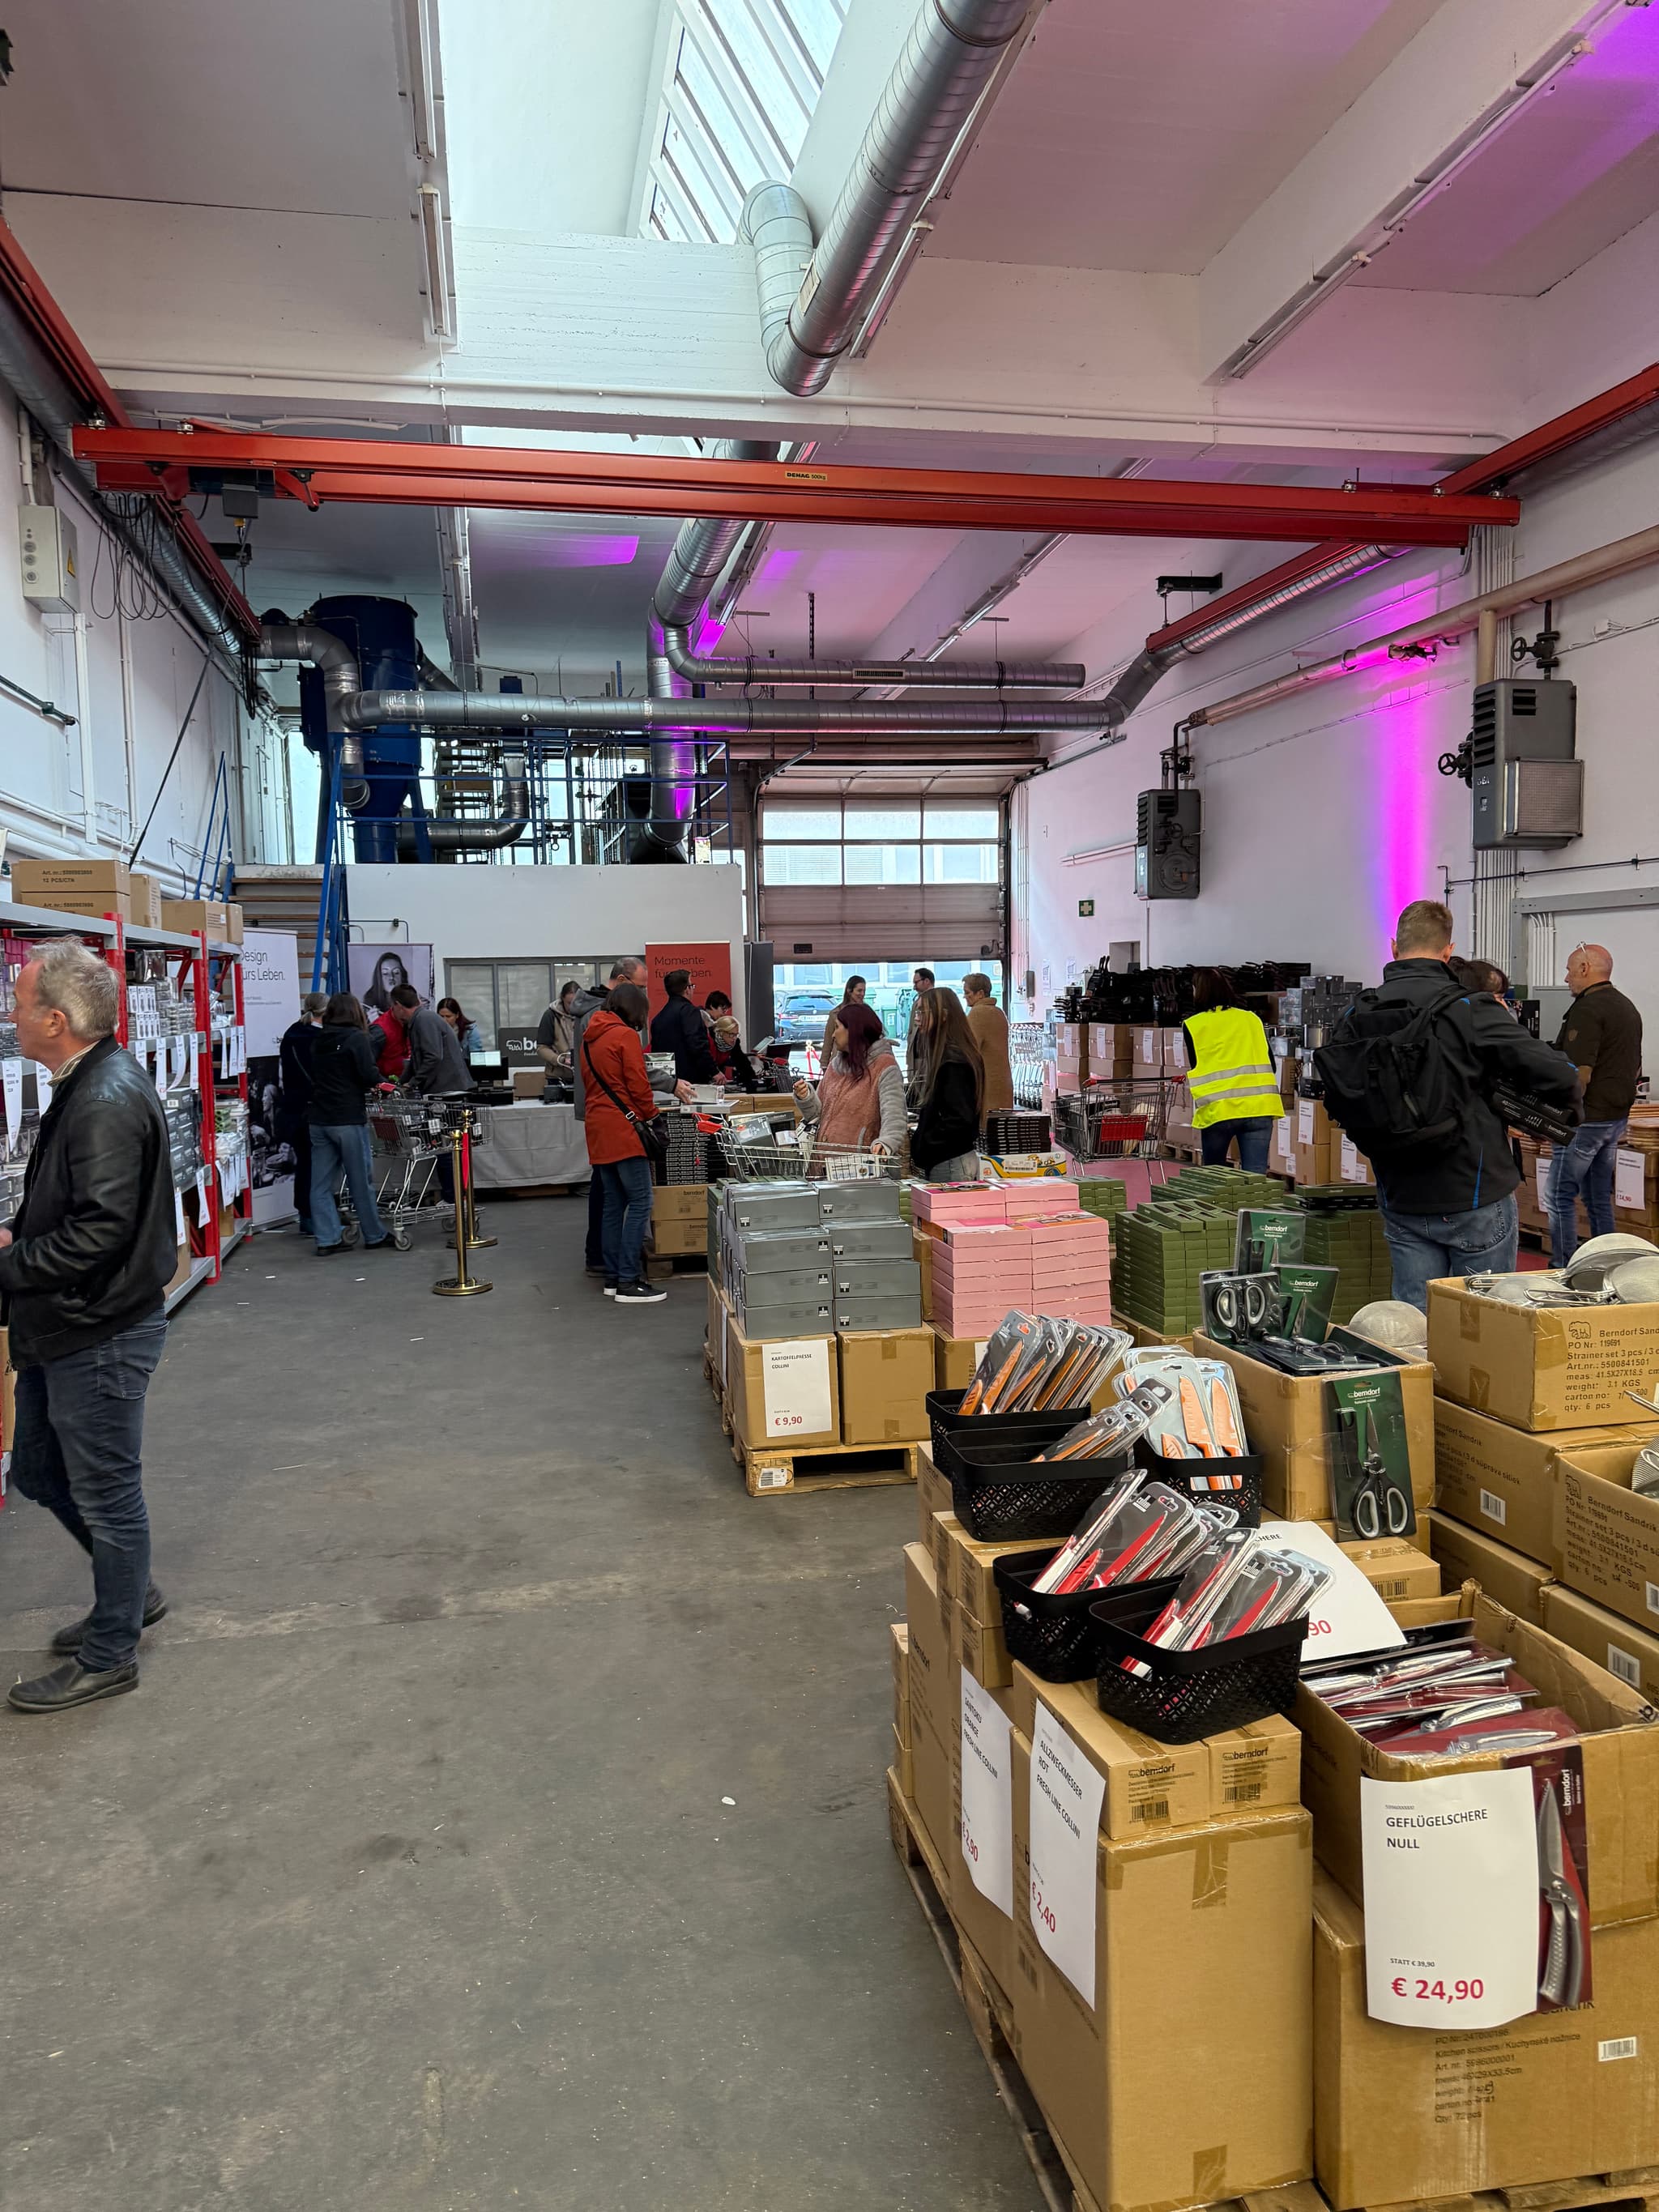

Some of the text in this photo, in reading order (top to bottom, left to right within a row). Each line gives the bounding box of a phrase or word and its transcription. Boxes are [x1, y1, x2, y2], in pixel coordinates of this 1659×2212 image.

[655, 956, 706, 966] Momente
[242, 967, 286, 981] ürs Leben.
[1265, 1224, 1288, 1232] berndorf
[1294, 1280, 1319, 1288] berndorf
[1599, 1328, 1637, 1338] Berndorf
[1567, 1341, 1581, 1349] PO
[771, 1353, 812, 1362] KARTOFFELPRESSE
[1567, 1352, 1604, 1361] Strainer
[1605, 1350, 1618, 1358] set
[1621, 1349, 1627, 1357] 3
[1627, 1349, 1643, 1358] pcs
[1648, 1348, 1654, 1356] 3
[1621, 1379, 1641, 1387] KGS
[1354, 1387, 1381, 1398] berndorf
[1595, 1401, 1611, 1413] pcs
[774, 1416, 803, 1426] € 9,90
[1587, 1495, 1657, 1532] Berndorf Sandrik
[1614, 1562, 1633, 1577] KGS
[1234, 1746, 1269, 1760] berndorf
[1038, 1755, 1051, 1775] ROT
[1039, 1739, 1083, 1801] ALLZWECKMESSER
[1139, 1762, 1176, 1777] berndorf
[1560, 1768, 1572, 1807] berndorf
[1035, 1773, 1081, 1841] FRESH LINE COLLINI
[1385, 1808, 1489, 1828] GEFLÜGELSCHERE
[1386, 1836, 1420, 1849] NULL
[1036, 1890, 1056, 1934] 2,40
[1389, 1958, 1410, 1967] STATT
[1417, 1960, 1436, 1968] 39,90
[1390, 1976, 1484, 2005] € 24,90
[1435, 2048, 1466, 2058] Kitchen
